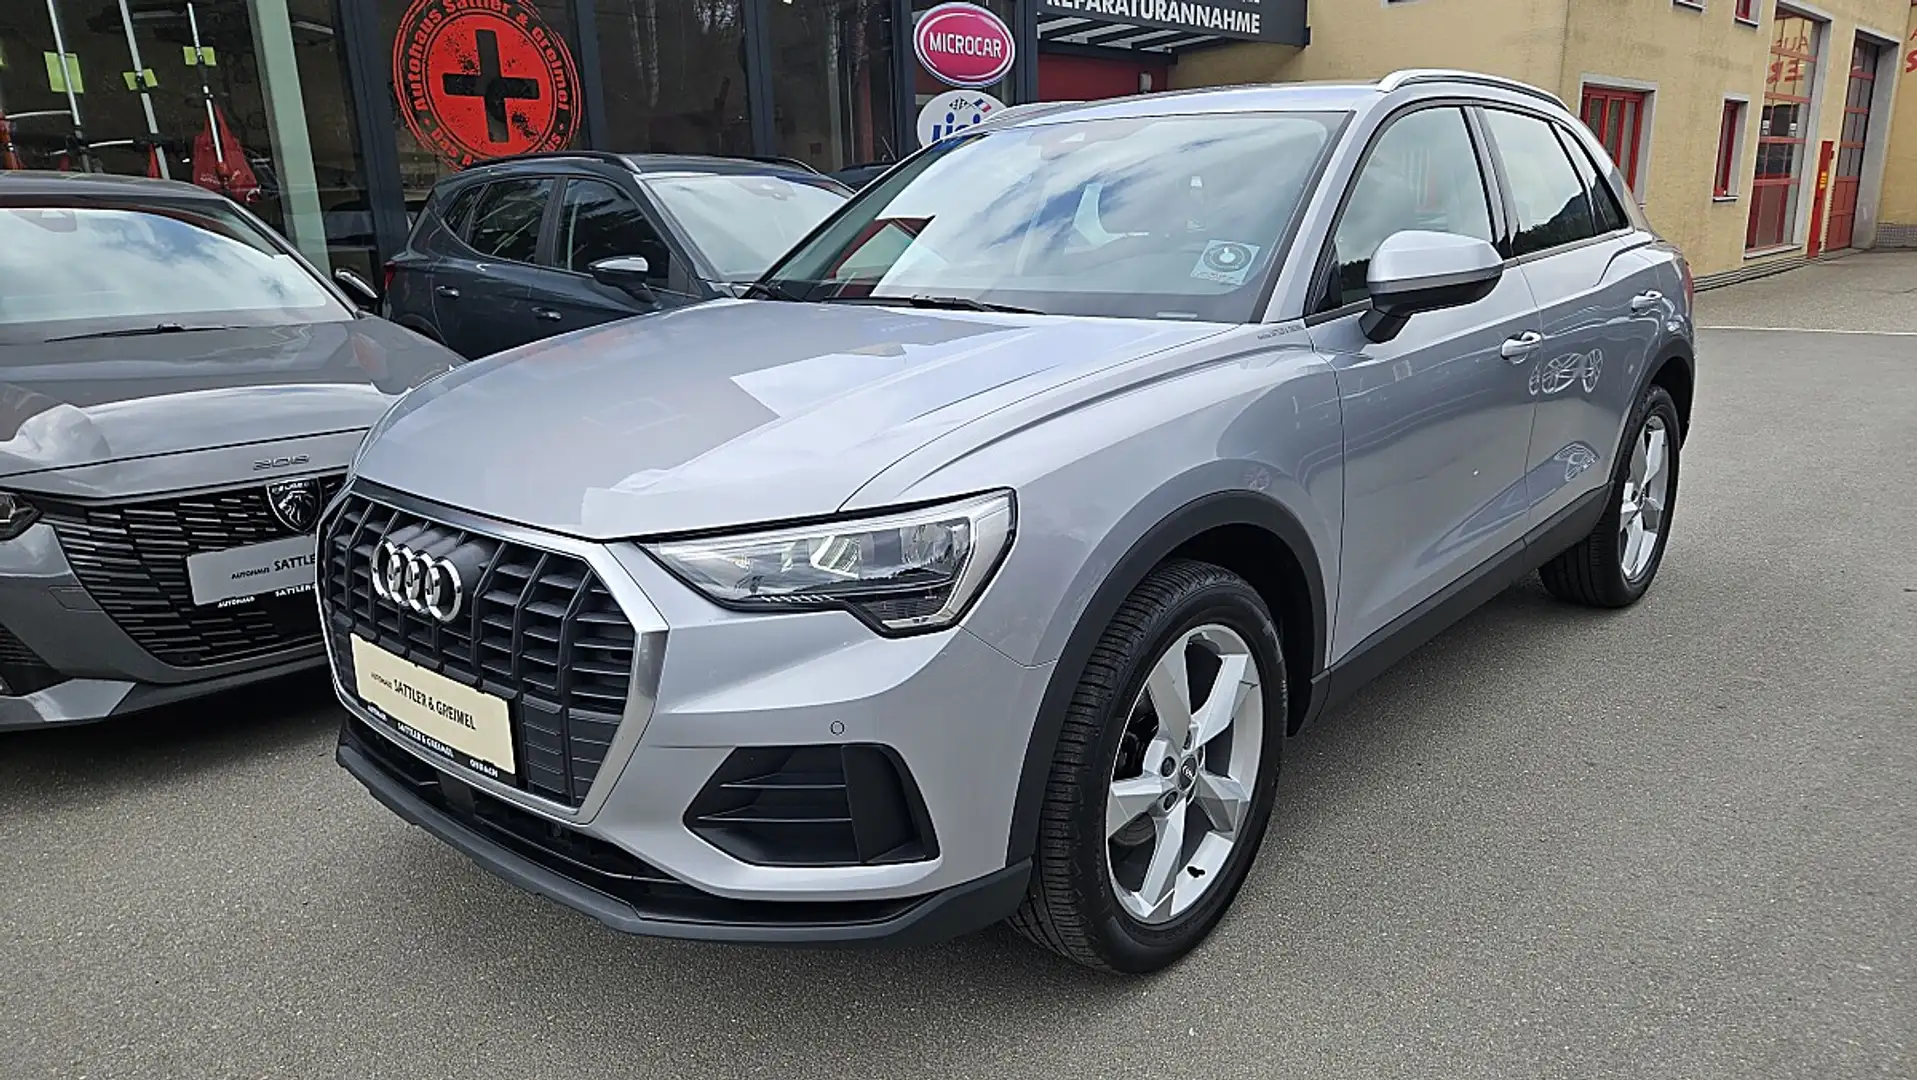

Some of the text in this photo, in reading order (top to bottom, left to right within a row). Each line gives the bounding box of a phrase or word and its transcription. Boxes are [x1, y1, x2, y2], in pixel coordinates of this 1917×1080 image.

[1046, 0, 1260, 34] ARATURANNAHME
[929, 31, 1002, 58] MICROCAR
[274, 553, 316, 572] SATTLE
[394, 678, 427, 708] SATTLER
[428, 696, 435, 712] &
[436, 701, 477, 731] GREIMEL
